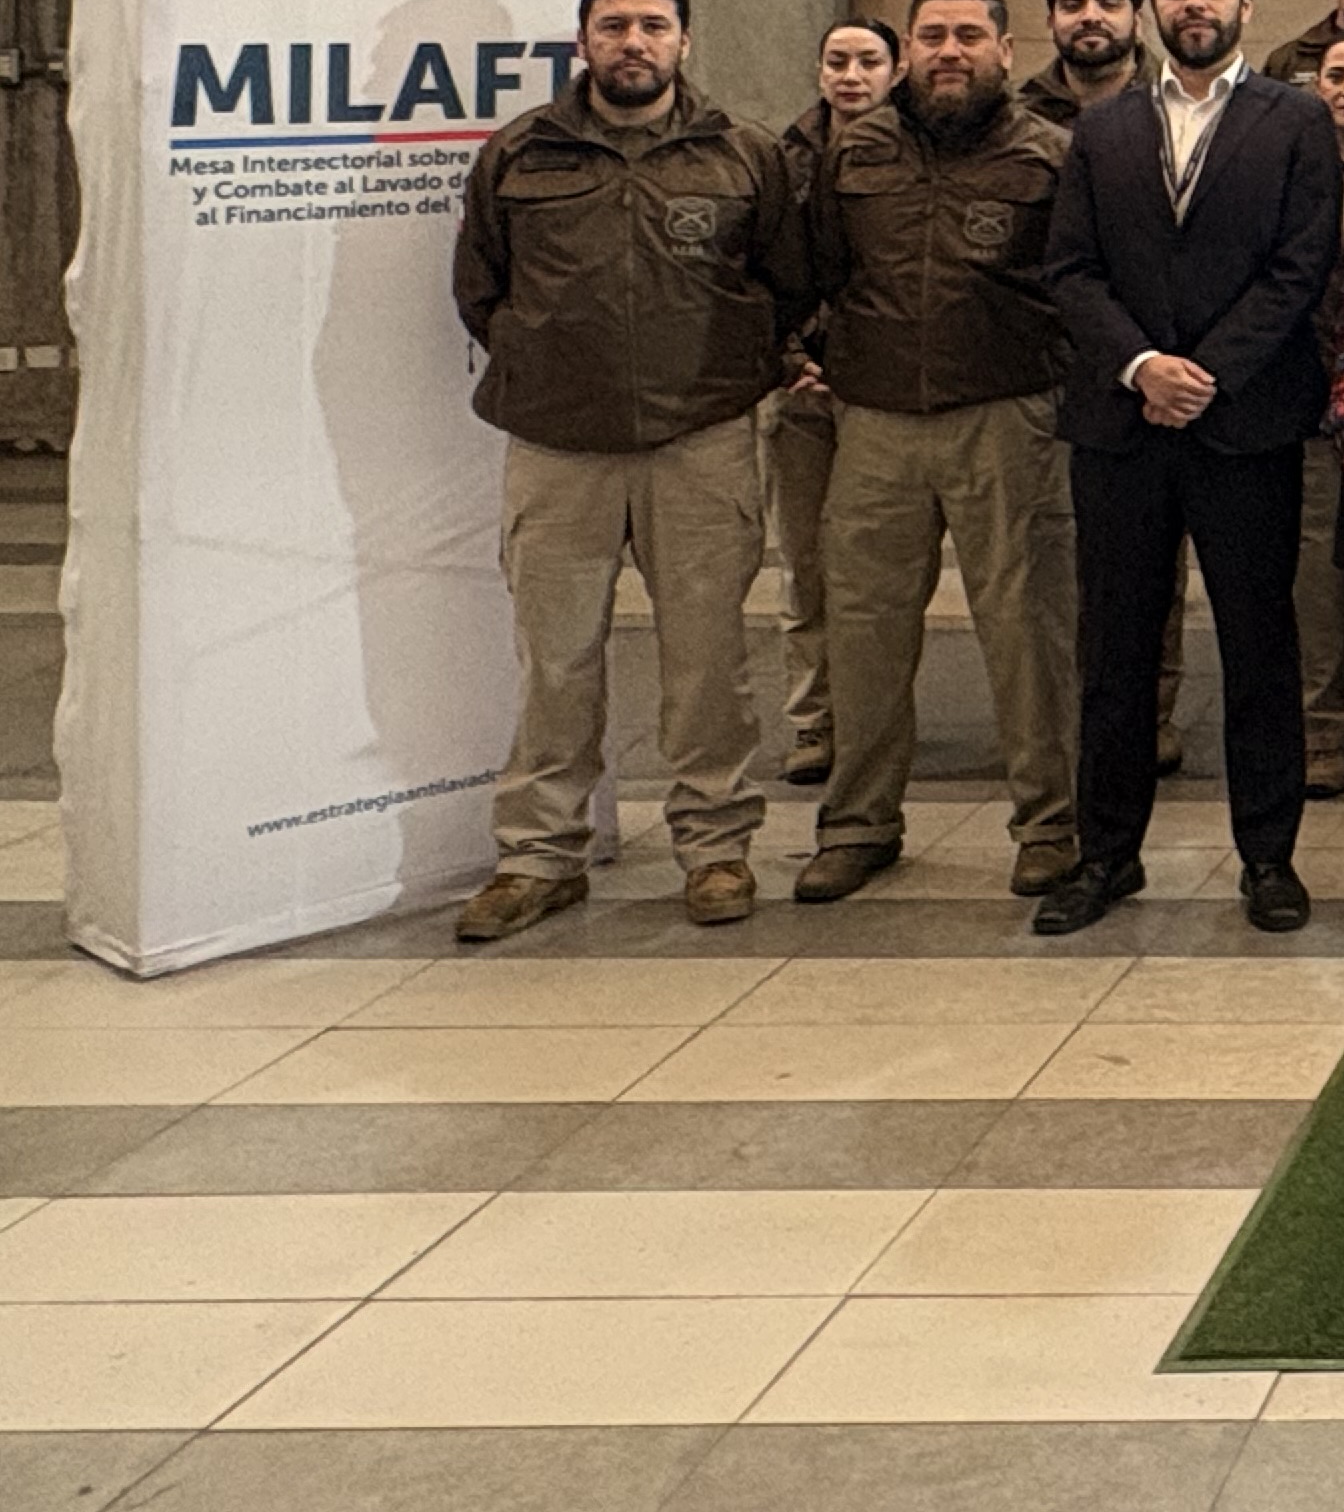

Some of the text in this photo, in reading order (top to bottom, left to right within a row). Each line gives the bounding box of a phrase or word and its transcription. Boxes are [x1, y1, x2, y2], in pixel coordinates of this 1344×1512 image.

[170, 148, 470, 176] Mesa Intersectorial sobre
[192, 183, 207, 204] y
[213, 178, 328, 201] Combate
[334, 174, 355, 194] al
[361, 172, 442, 193] Lavado
[196, 204, 219, 226] al
[224, 196, 411, 225] Financiamiento
[415, 194, 451, 214] del
